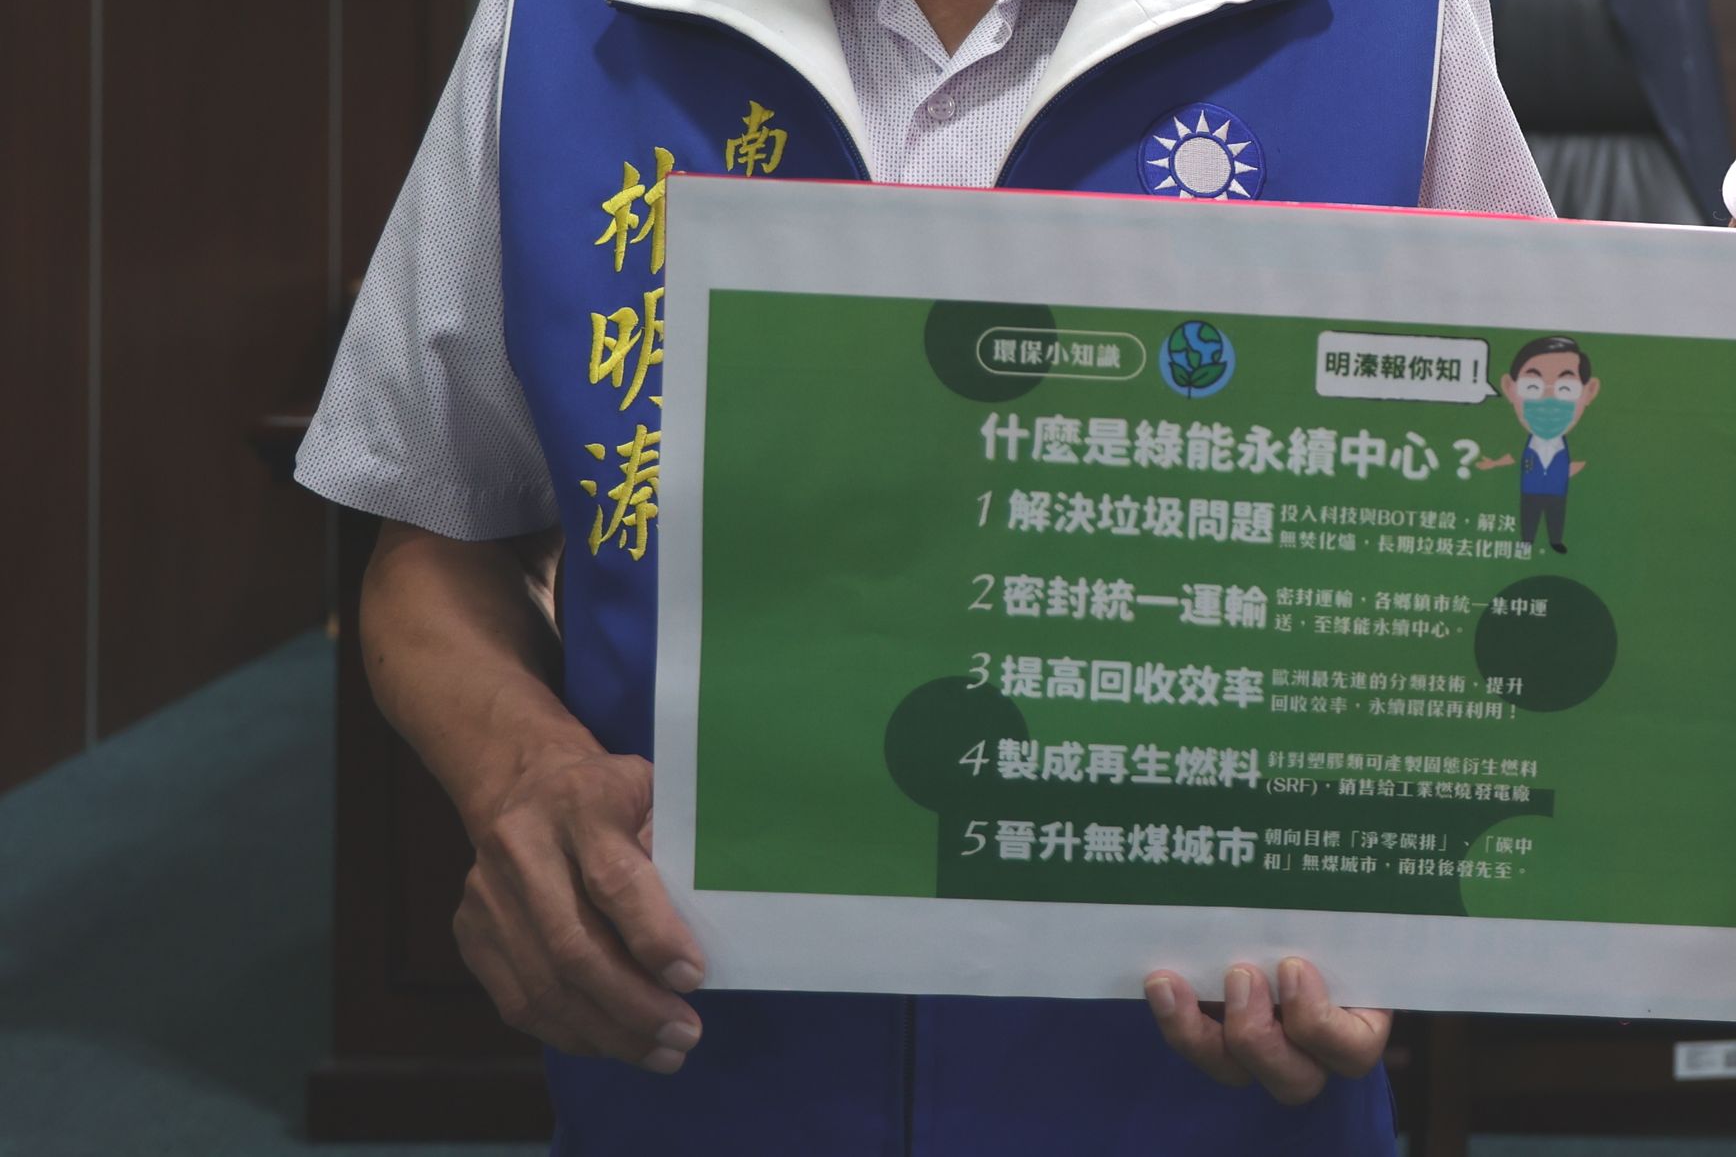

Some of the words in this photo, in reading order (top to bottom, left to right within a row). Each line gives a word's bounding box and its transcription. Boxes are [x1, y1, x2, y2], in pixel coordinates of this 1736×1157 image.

[992, 339, 1122, 370] 環保小知識
[1325, 351, 1481, 385] 明溱報你知！
[979, 411, 1482, 482] 什麼是綠能永續中心？
[974, 490, 994, 528] 1
[1008, 488, 1276, 544] 解決垃圾問題
[968, 574, 996, 612] 2
[1001, 573, 1269, 630] 密封統一運輸
[965, 651, 990, 690] 3
[1000, 654, 1266, 710] 提高回收效率
[958, 739, 990, 777] 4
[996, 737, 1262, 789] 製成再生燃料
[959, 819, 990, 857] 5
[994, 818, 1259, 866] 晉升無煤城市
